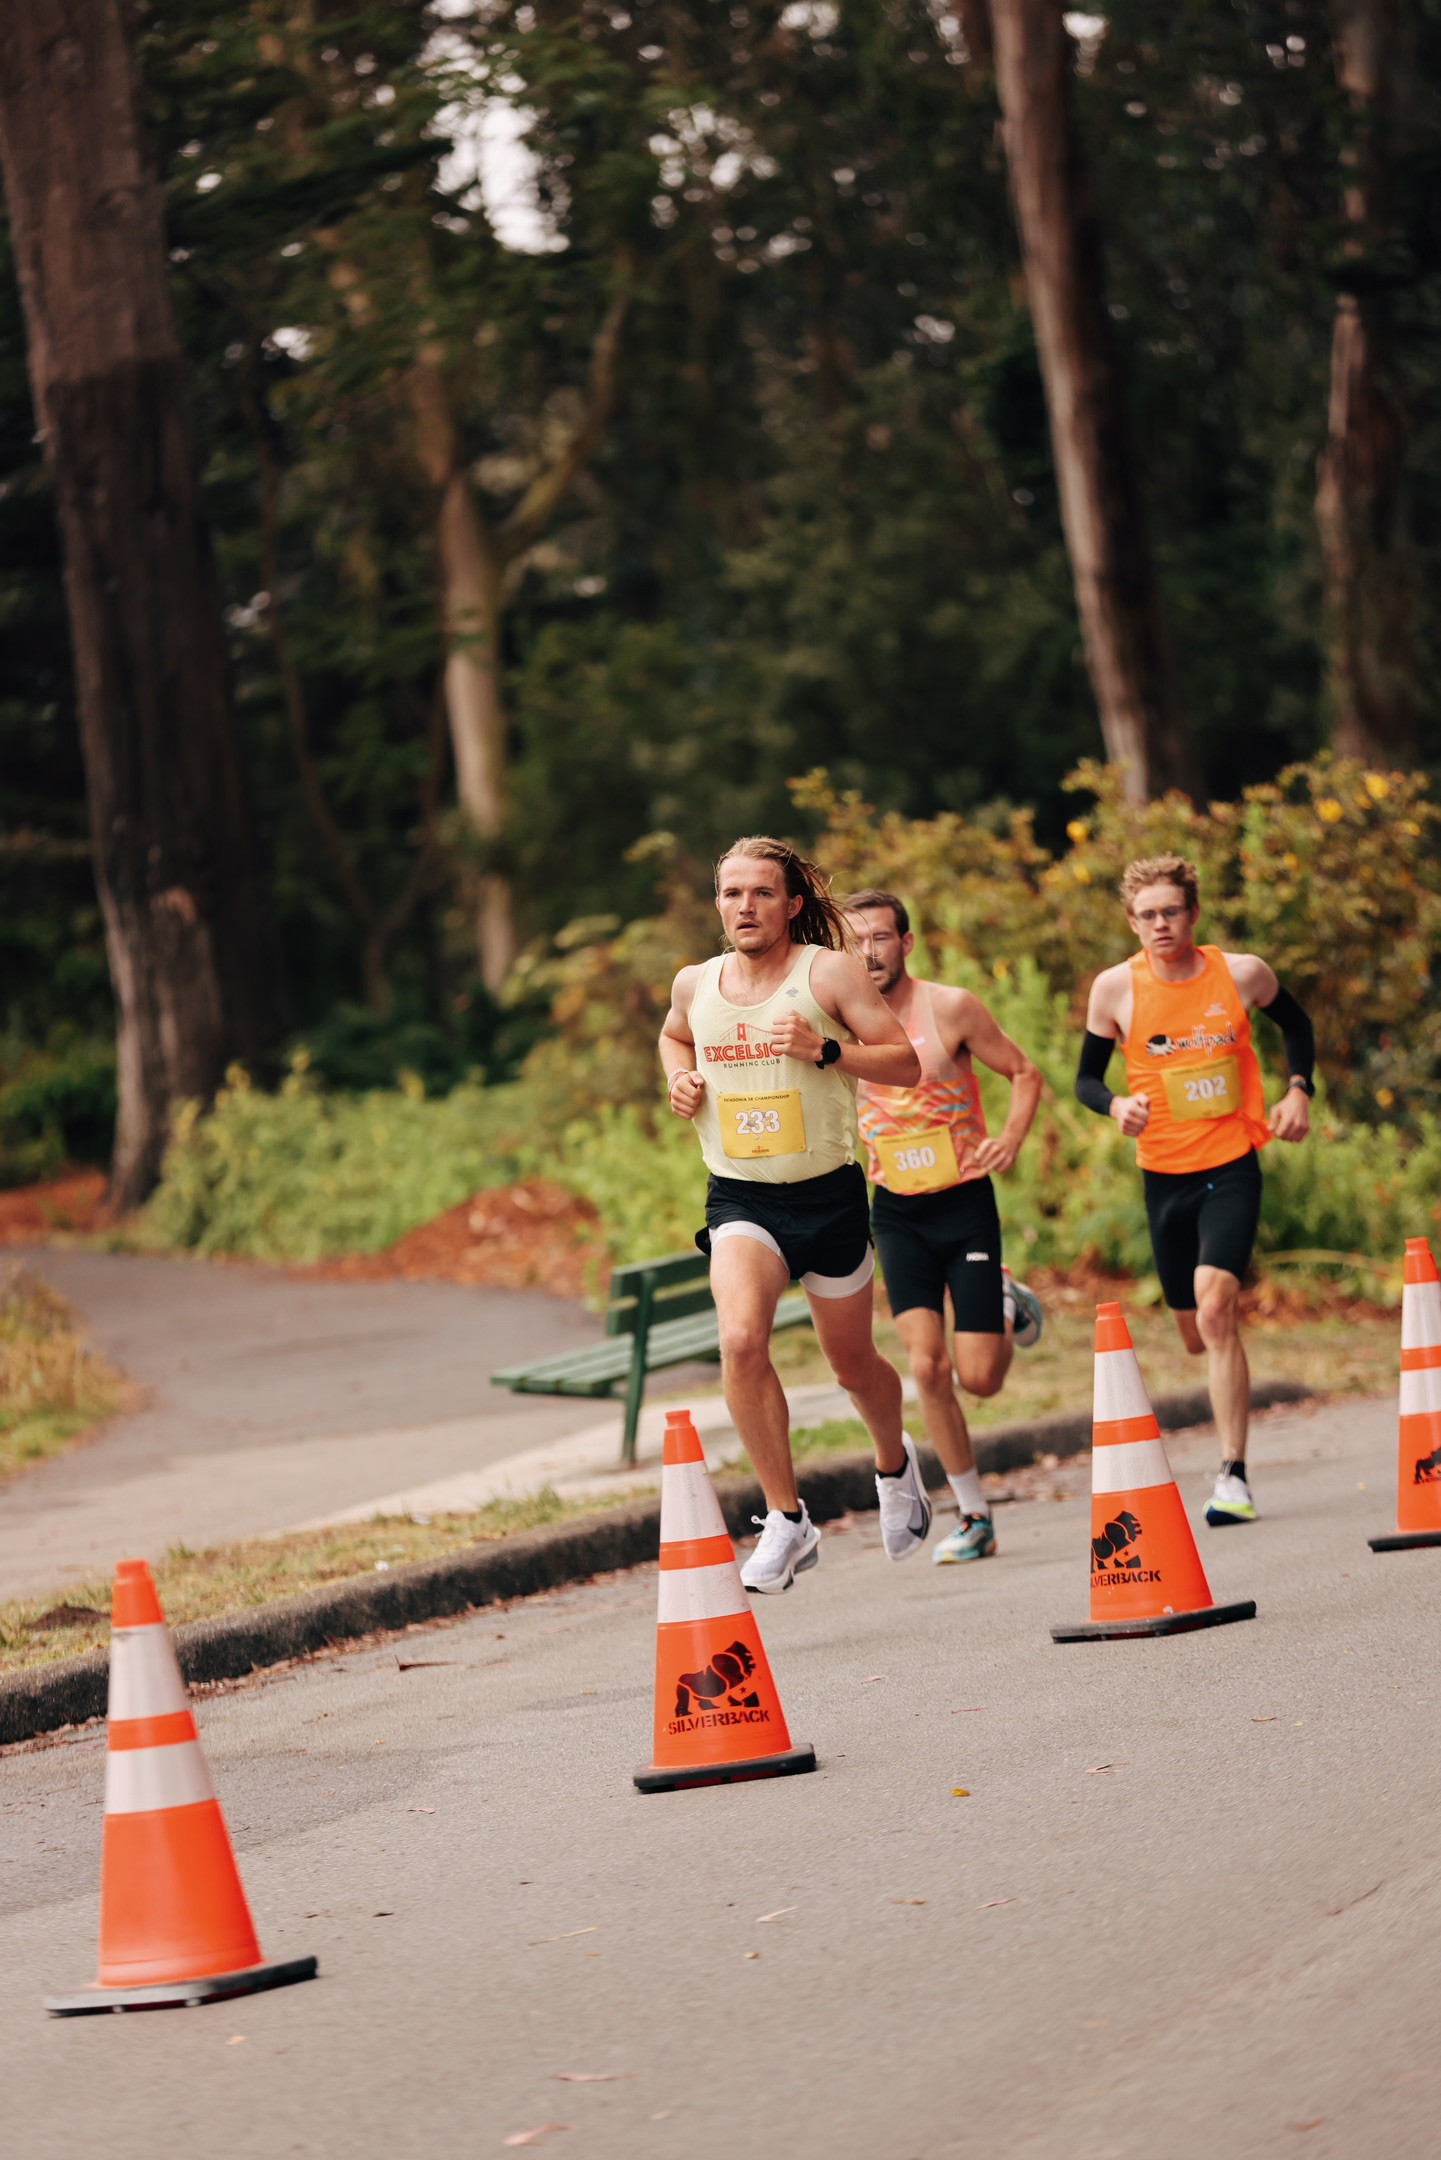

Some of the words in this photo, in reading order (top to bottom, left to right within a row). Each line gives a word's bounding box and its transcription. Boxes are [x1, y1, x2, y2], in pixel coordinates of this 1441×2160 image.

[703, 1042, 783, 1062] EXCELSIO
[723, 1060, 759, 1069] RUNNING
[761, 1058, 781, 1067] CLUB
[754, 1094, 790, 1102] CHAMPIONSHIP
[1183, 1075, 1229, 1102] 202
[735, 1109, 780, 1135] 233
[893, 1145, 936, 1172] 360
[668, 1710, 770, 1735] SILVERBACK
